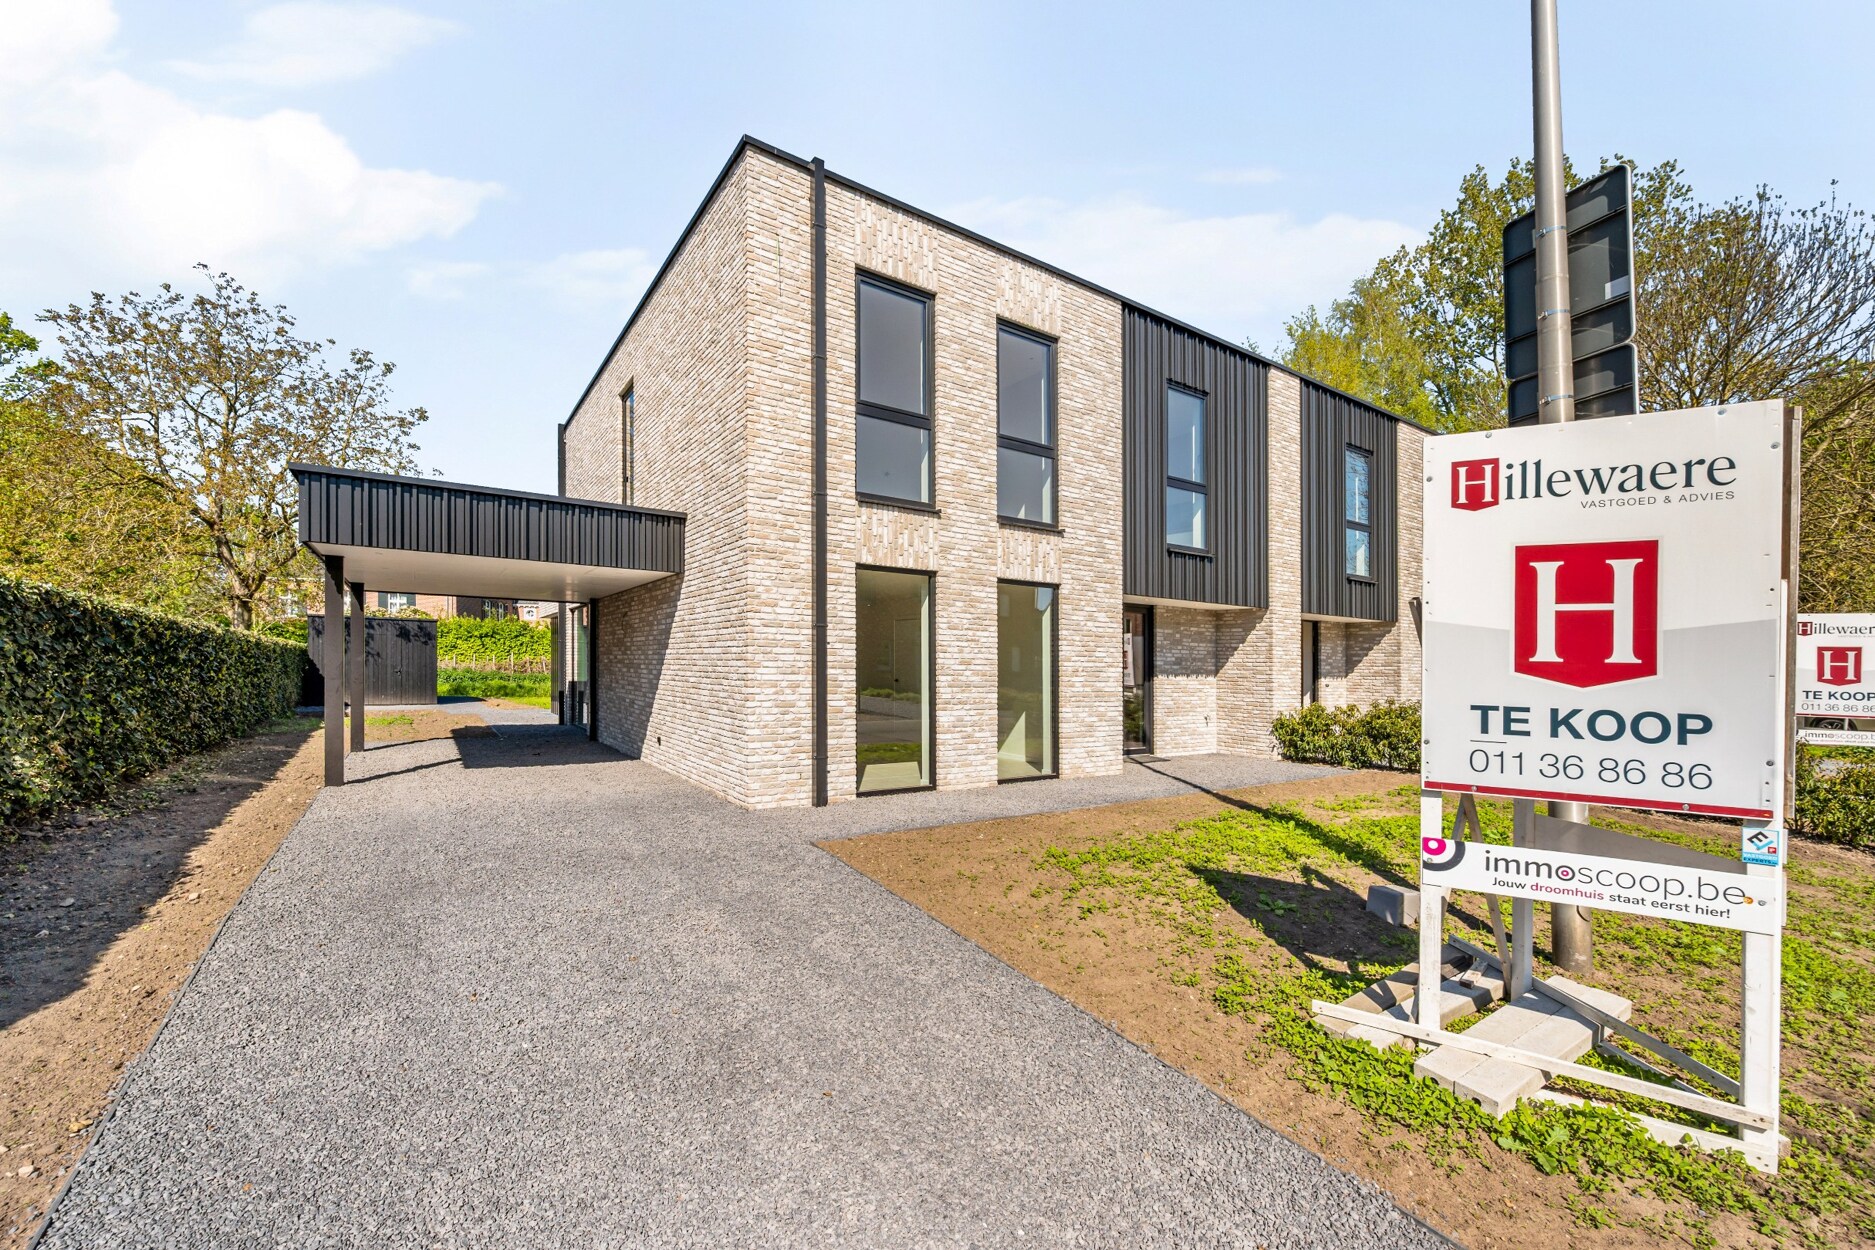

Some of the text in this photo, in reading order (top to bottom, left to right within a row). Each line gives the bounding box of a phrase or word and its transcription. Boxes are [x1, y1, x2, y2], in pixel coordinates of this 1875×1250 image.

[1456, 456, 1737, 504] Hillewaere
[1581, 491, 1735, 509] VASTGOED & ADVIES
[1529, 558, 1643, 663] H
[1821, 651, 1858, 680] H
[1801, 702, 1820, 711] 011
[1824, 703, 1840, 711] 36
[1843, 704, 1858, 712] 86
[1802, 690, 1875, 701] TE KOOP
[1470, 704, 1713, 746] TE KOOP
[1469, 749, 1713, 790] 011 36 86 86
[1485, 849, 1745, 904] immoscoop.be
[1492, 877, 1730, 919] Jouw droomhuis staat eerst hier!
